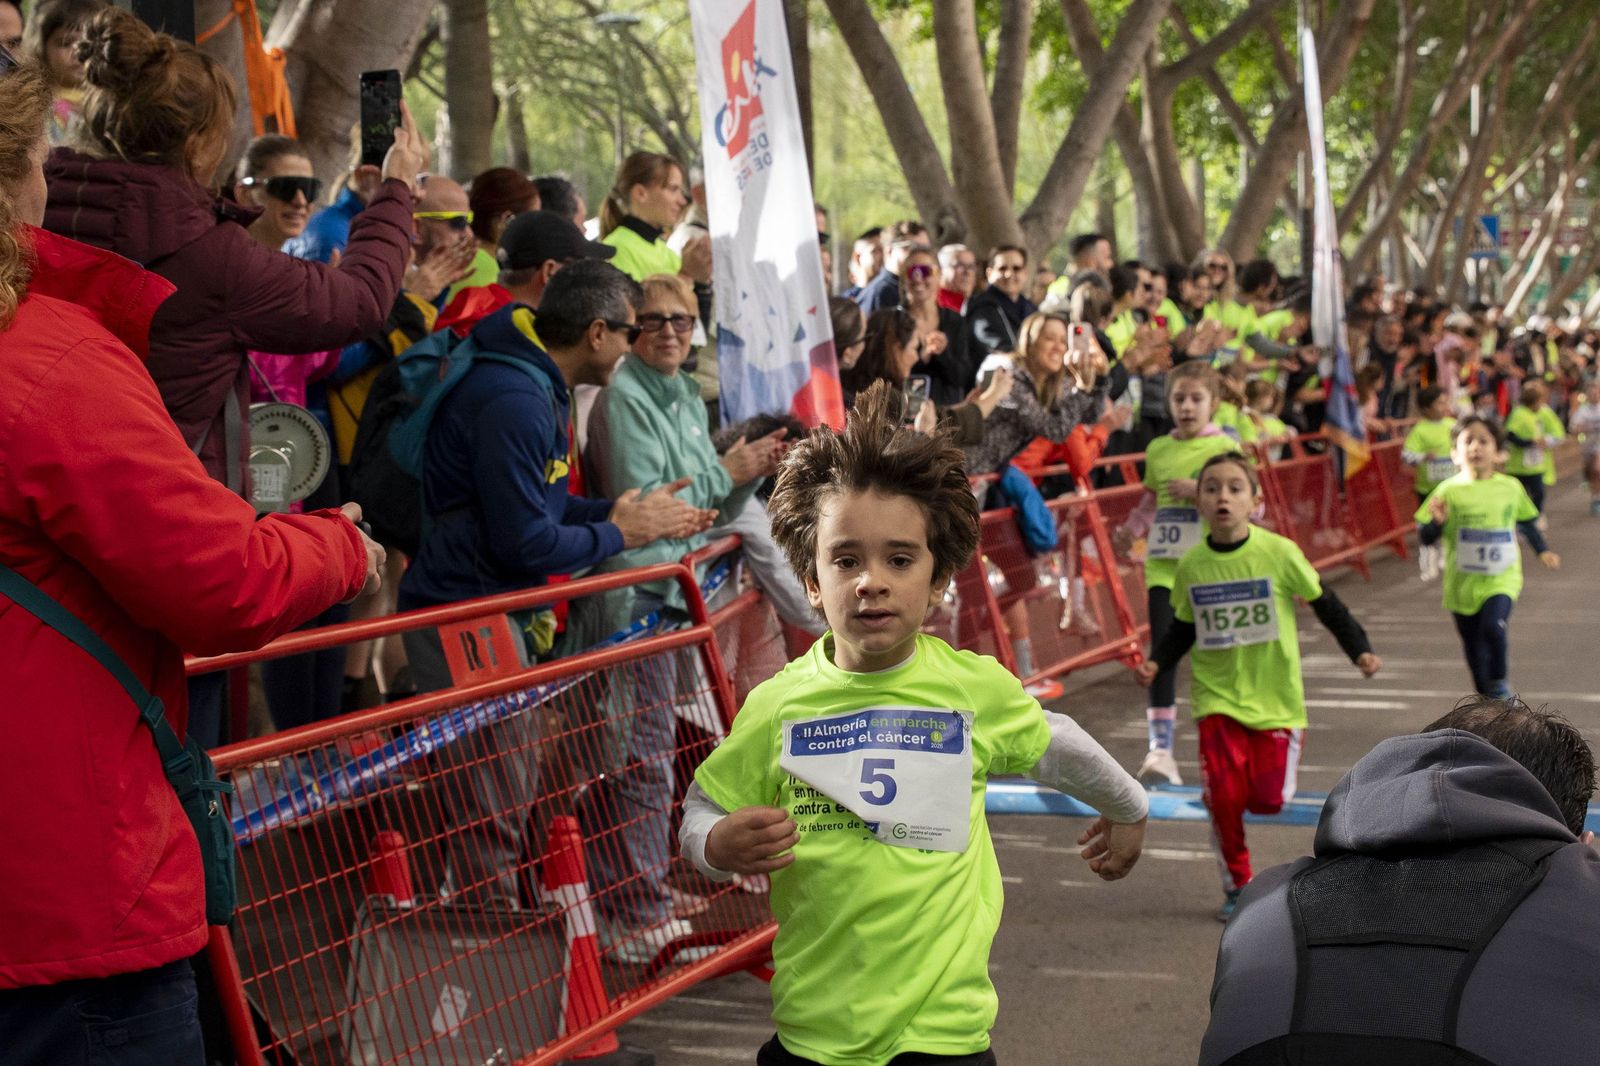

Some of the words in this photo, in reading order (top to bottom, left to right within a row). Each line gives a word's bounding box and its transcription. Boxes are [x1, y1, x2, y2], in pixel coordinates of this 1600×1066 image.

[1157, 525, 1180, 544] 30
[1476, 547, 1501, 562] 16
[1201, 603, 1270, 632] 1528
[459, 626, 498, 673] RT
[803, 727, 812, 738] II
[814, 717, 867, 738] Almería
[871, 718, 888, 728] en
[893, 717, 948, 731] marcha
[808, 735, 855, 751] contra
[858, 731, 873, 743] el
[876, 731, 926, 745] cáncer
[859, 758, 897, 807] 5
[794, 787, 806, 799] en
[793, 801, 831, 816] contra
[799, 824, 807, 832] de
[808, 821, 844, 833] febrero
[847, 819, 860, 829] de
